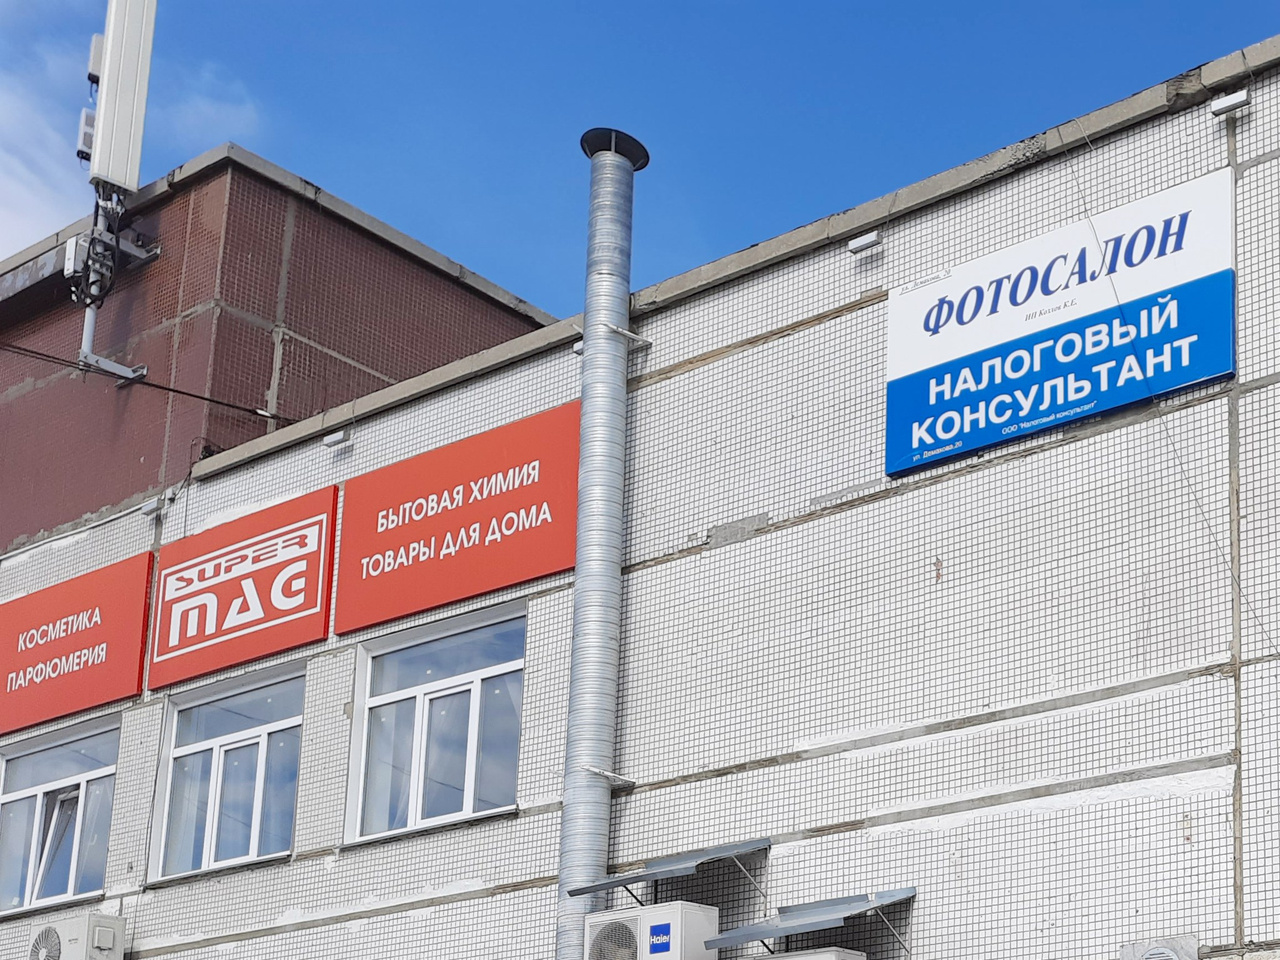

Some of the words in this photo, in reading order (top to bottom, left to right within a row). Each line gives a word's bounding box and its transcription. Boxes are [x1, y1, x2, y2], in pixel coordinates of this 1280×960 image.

[922, 209, 1192, 337] ФОТОСАЛОН
[928, 293, 1178, 405] НАЛОГОВЫЙ
[911, 334, 1198, 449] КОНСУЛЬТАНТ
[377, 490, 464, 532] БЫТОВАЯ
[468, 459, 540, 501] ХИМИЯ
[173, 532, 313, 593] SUPER
[361, 544, 435, 580] ТОВАРЫ
[438, 528, 481, 558] ДЛЯ
[485, 501, 552, 543] ДОМА
[17, 606, 102, 653] КОСМЕТИКА
[6, 642, 107, 693] ПАРФЮМЕРИЯ
[650, 934, 670, 944] Haier
